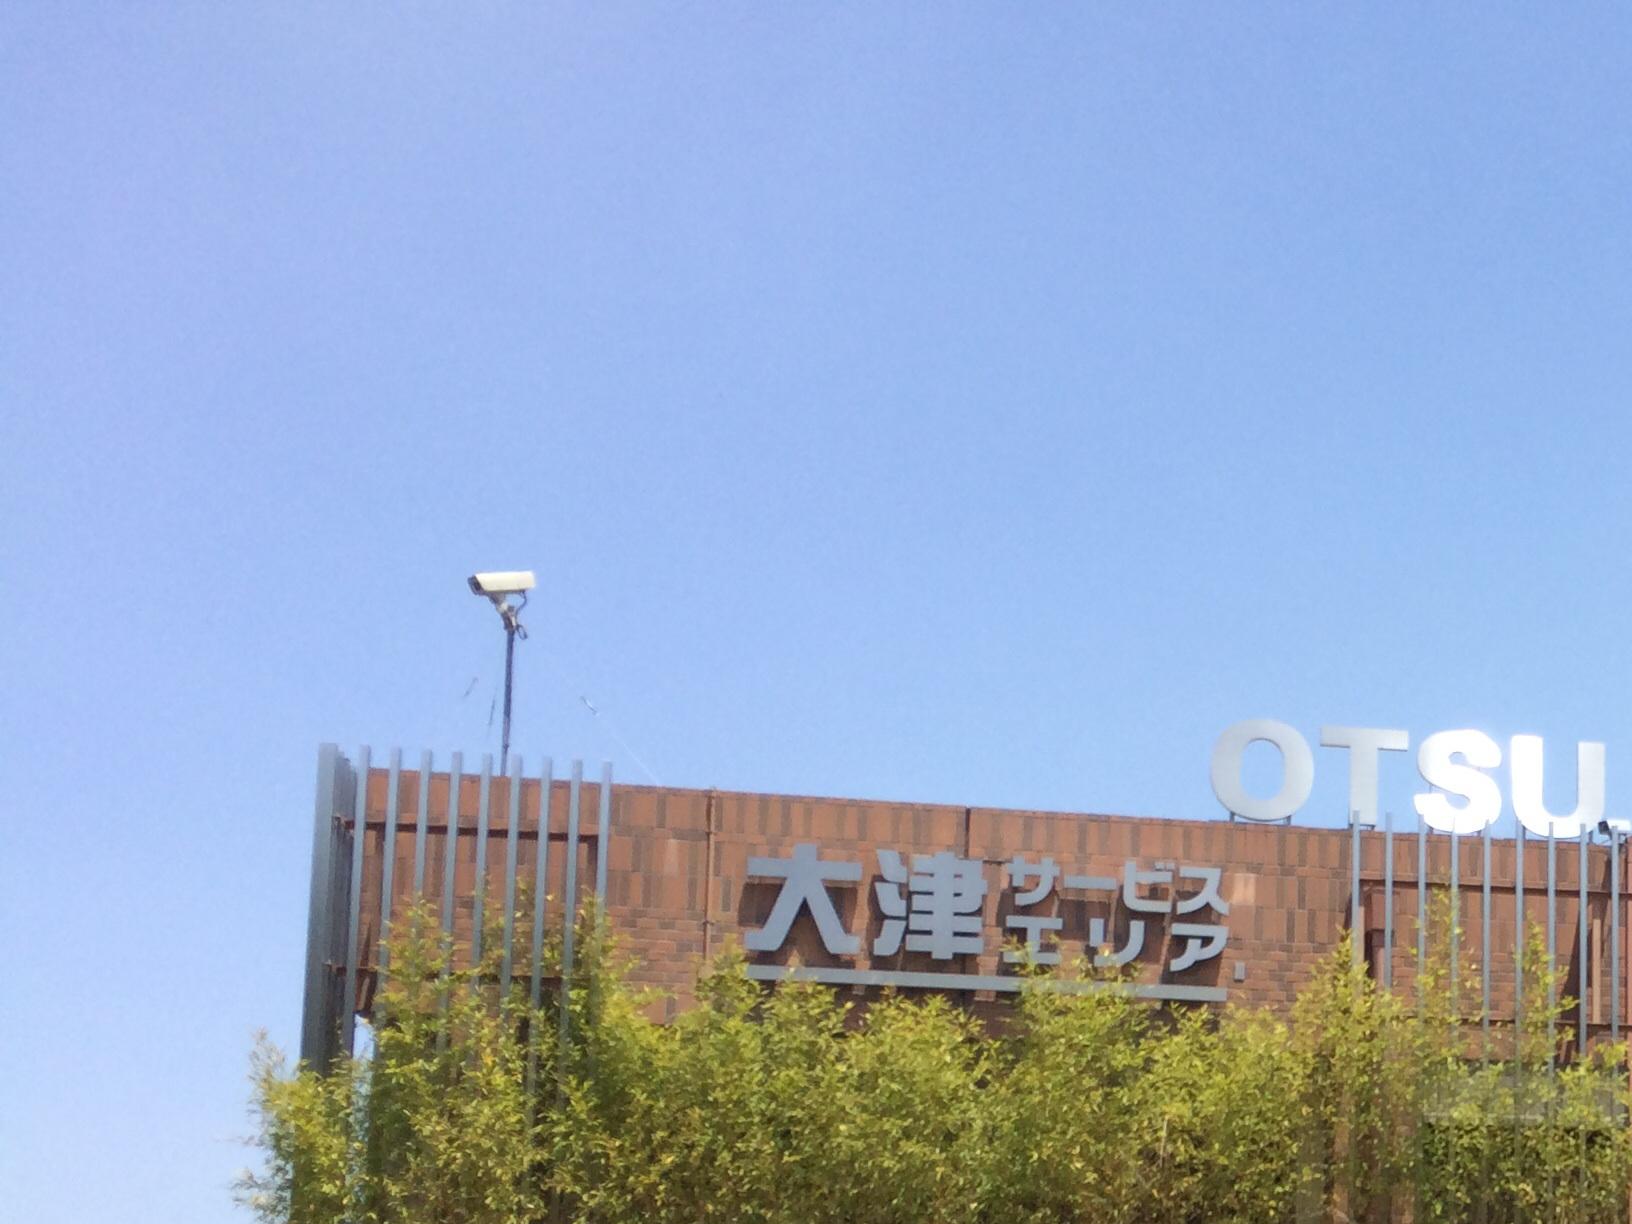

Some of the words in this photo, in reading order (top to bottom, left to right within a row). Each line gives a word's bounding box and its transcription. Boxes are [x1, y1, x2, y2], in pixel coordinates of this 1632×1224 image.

[1210, 718, 1606, 840] OTSU
[744, 842, 988, 960] 大津
[1007, 855, 1230, 917] サービス
[1003, 916, 1230, 973] エリア
